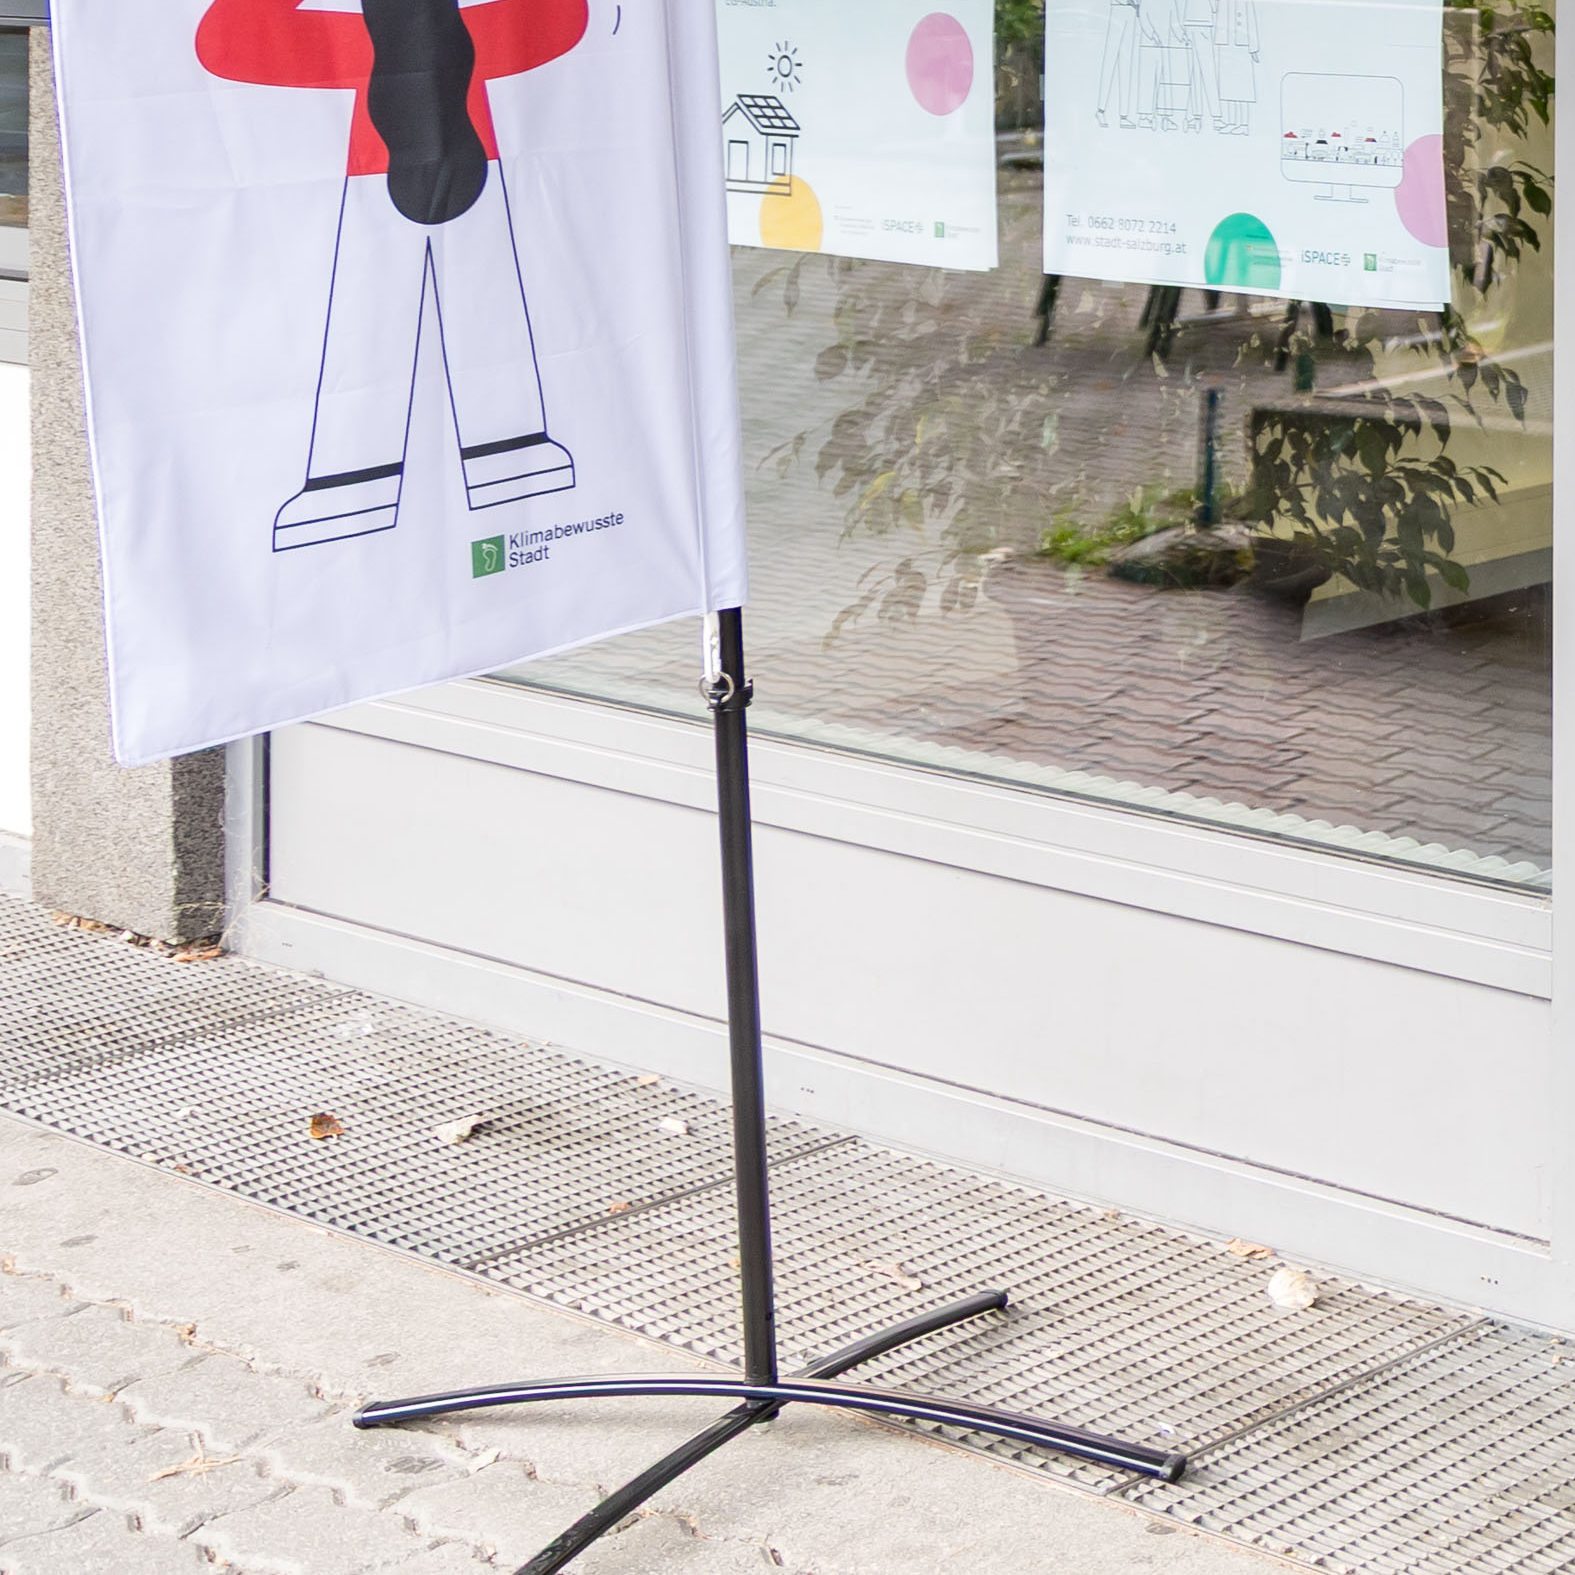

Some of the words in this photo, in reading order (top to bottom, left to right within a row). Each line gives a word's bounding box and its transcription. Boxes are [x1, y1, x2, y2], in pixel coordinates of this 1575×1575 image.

[1088, 216, 1115, 230] 0662
[1149, 220, 1176, 234] 2214
[509, 511, 624, 550] Klimabewusste
[509, 545, 550, 568] Stadt
